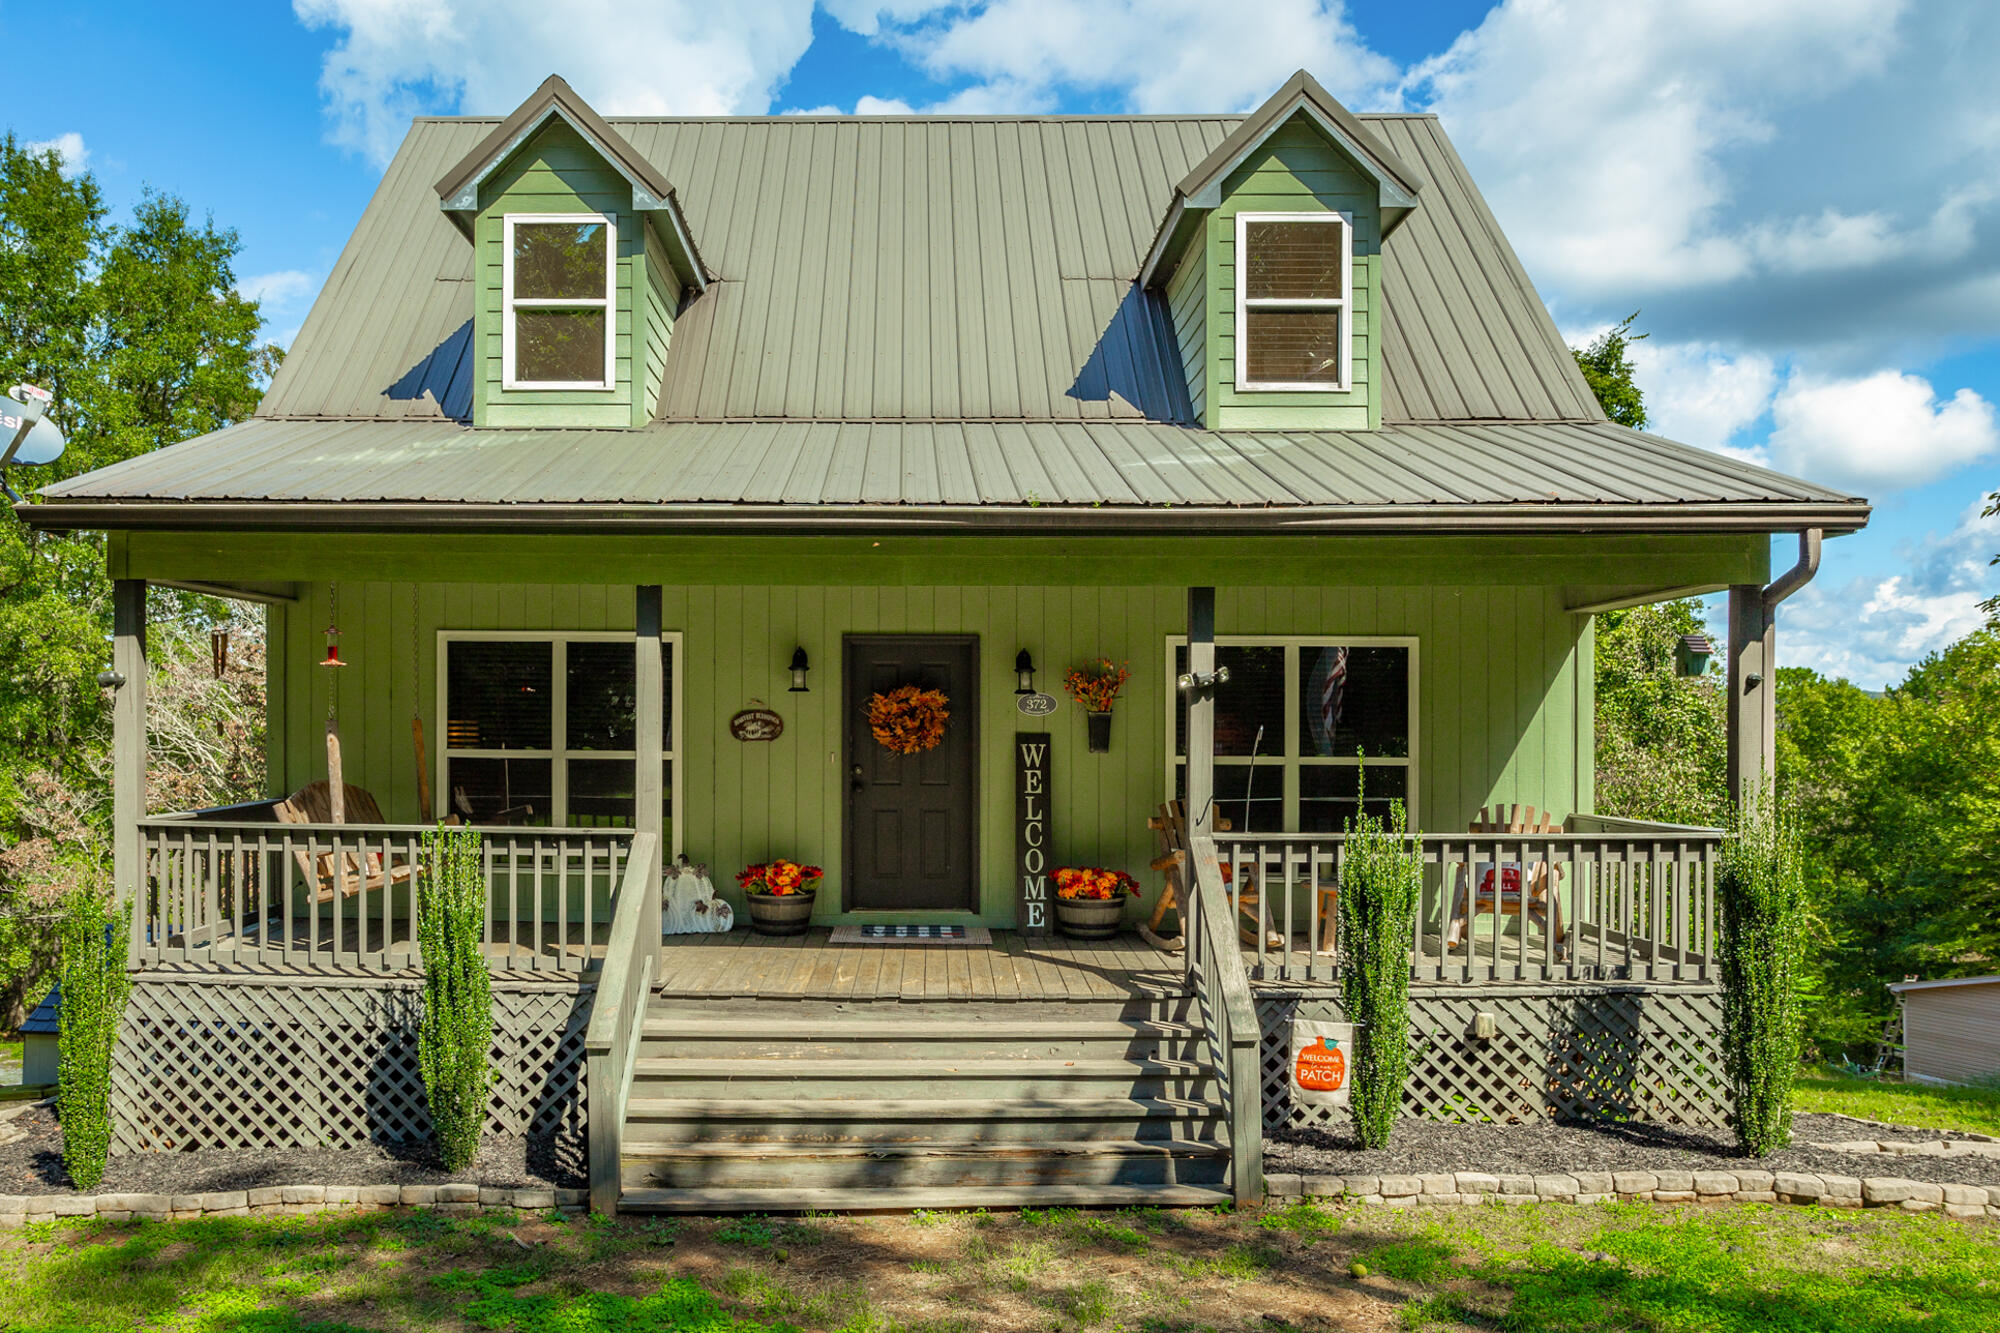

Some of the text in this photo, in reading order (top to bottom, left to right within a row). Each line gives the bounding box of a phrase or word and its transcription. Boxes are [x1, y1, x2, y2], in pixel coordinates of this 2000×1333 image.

[1026, 699, 1047, 709] 372
[1020, 744, 1047, 927] WELCOME
[1302, 1053, 1340, 1063] WELCOME
[1301, 1069, 1341, 1082] PATCH
